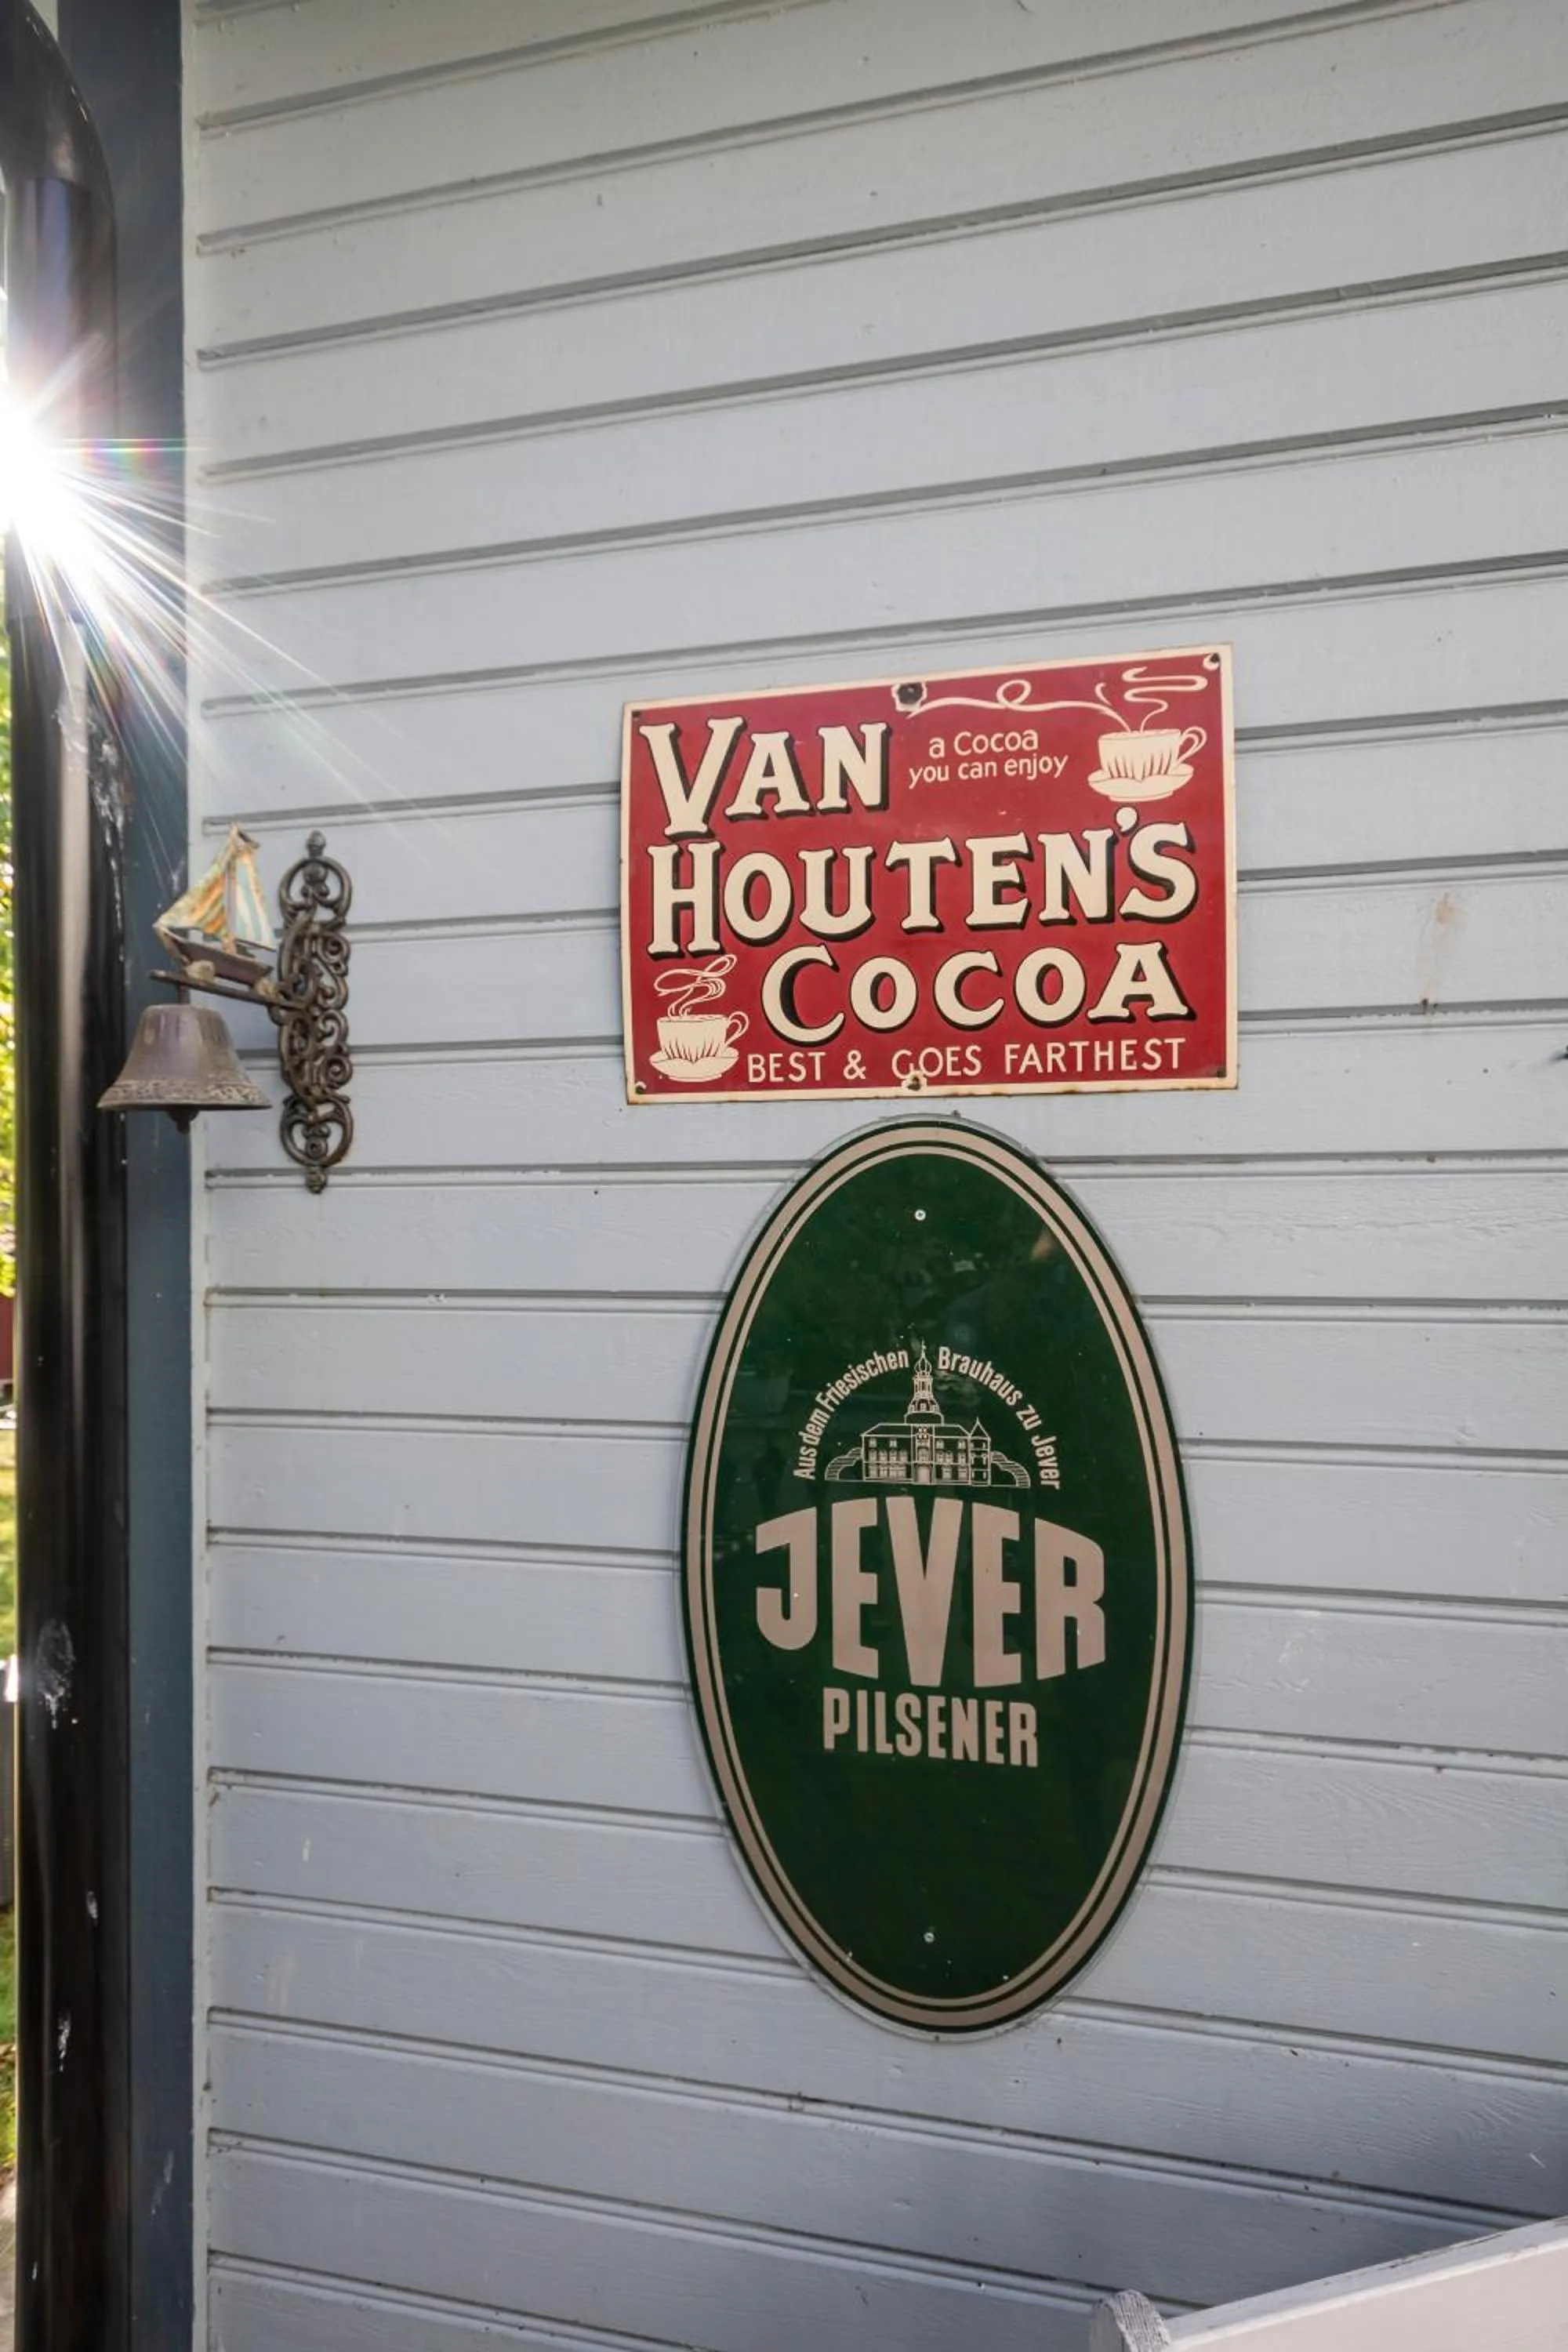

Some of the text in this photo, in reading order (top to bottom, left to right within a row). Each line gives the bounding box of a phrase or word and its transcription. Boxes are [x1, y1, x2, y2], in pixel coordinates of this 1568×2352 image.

[639, 717, 891, 840] VAN
[908, 753, 1069, 790] you can enjoy
[928, 728, 1040, 760] a Cocoa
[646, 805, 1198, 960] HOUTEN'S
[760, 941, 1197, 1047] COCOA
[746, 1037, 1186, 1083] BEST & GOES FARTHEST
[793, 1345, 1061, 1490] Aus dem Friesischen Brauhaus zu Jever
[755, 1495, 1106, 1688] JEVER
[822, 1686, 1039, 1769] PILSENER
